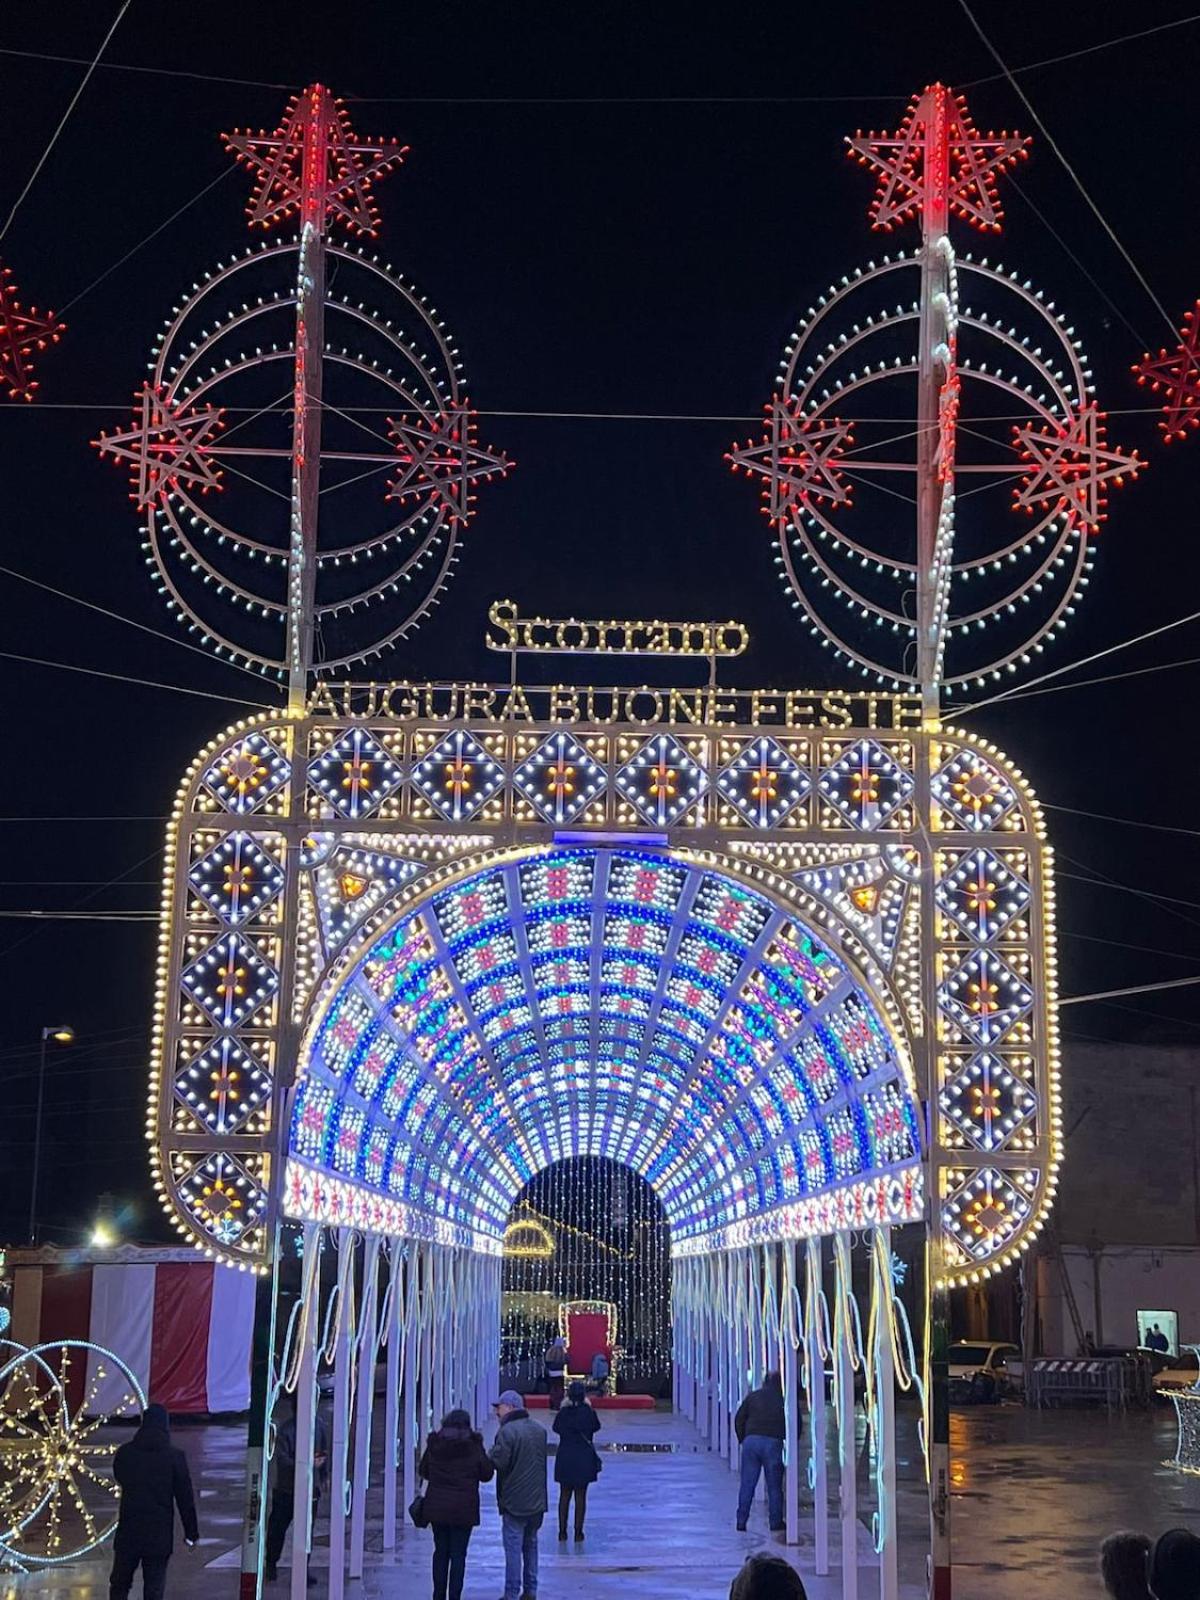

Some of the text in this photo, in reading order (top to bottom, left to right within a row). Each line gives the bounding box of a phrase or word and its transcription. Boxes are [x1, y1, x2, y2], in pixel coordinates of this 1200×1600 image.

[486, 598, 750, 656] Scorrano
[305, 680, 923, 731] AUGURA BUONE FESTE
